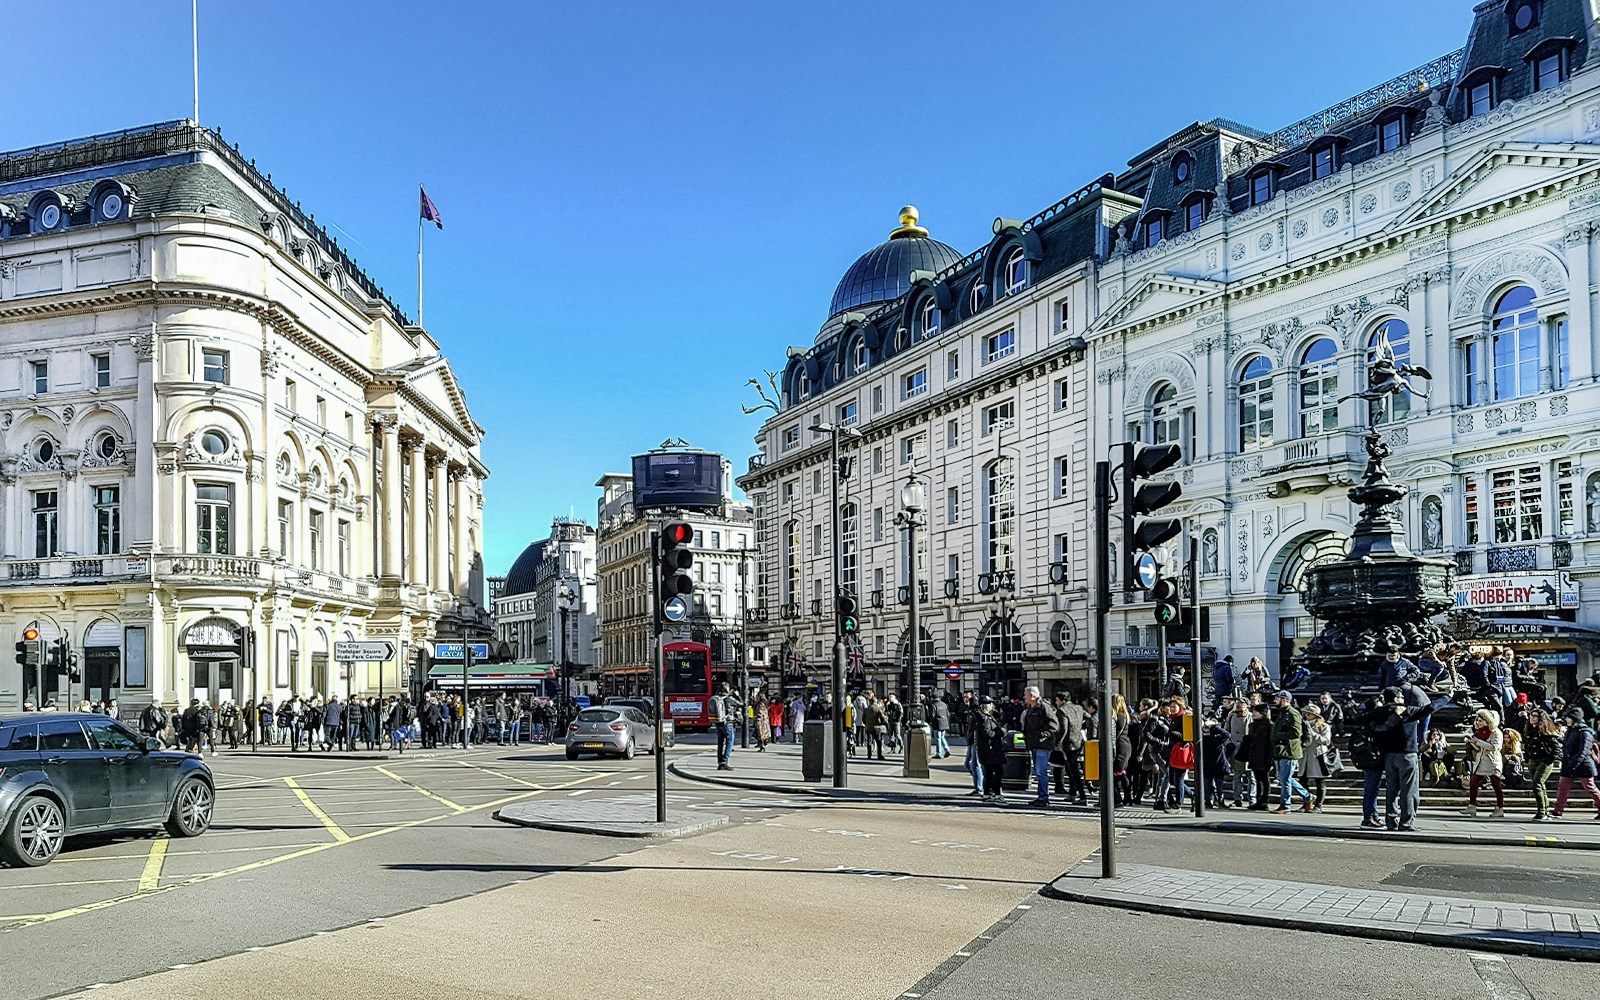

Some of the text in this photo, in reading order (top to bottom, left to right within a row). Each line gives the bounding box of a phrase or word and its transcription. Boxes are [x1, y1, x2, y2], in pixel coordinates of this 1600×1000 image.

[1465, 581, 1485, 589] COMEDY
[1455, 587, 1531, 606] NK ROBBERY
[1496, 624, 1543, 633] THEATRE
[681, 661, 690, 669] 94
